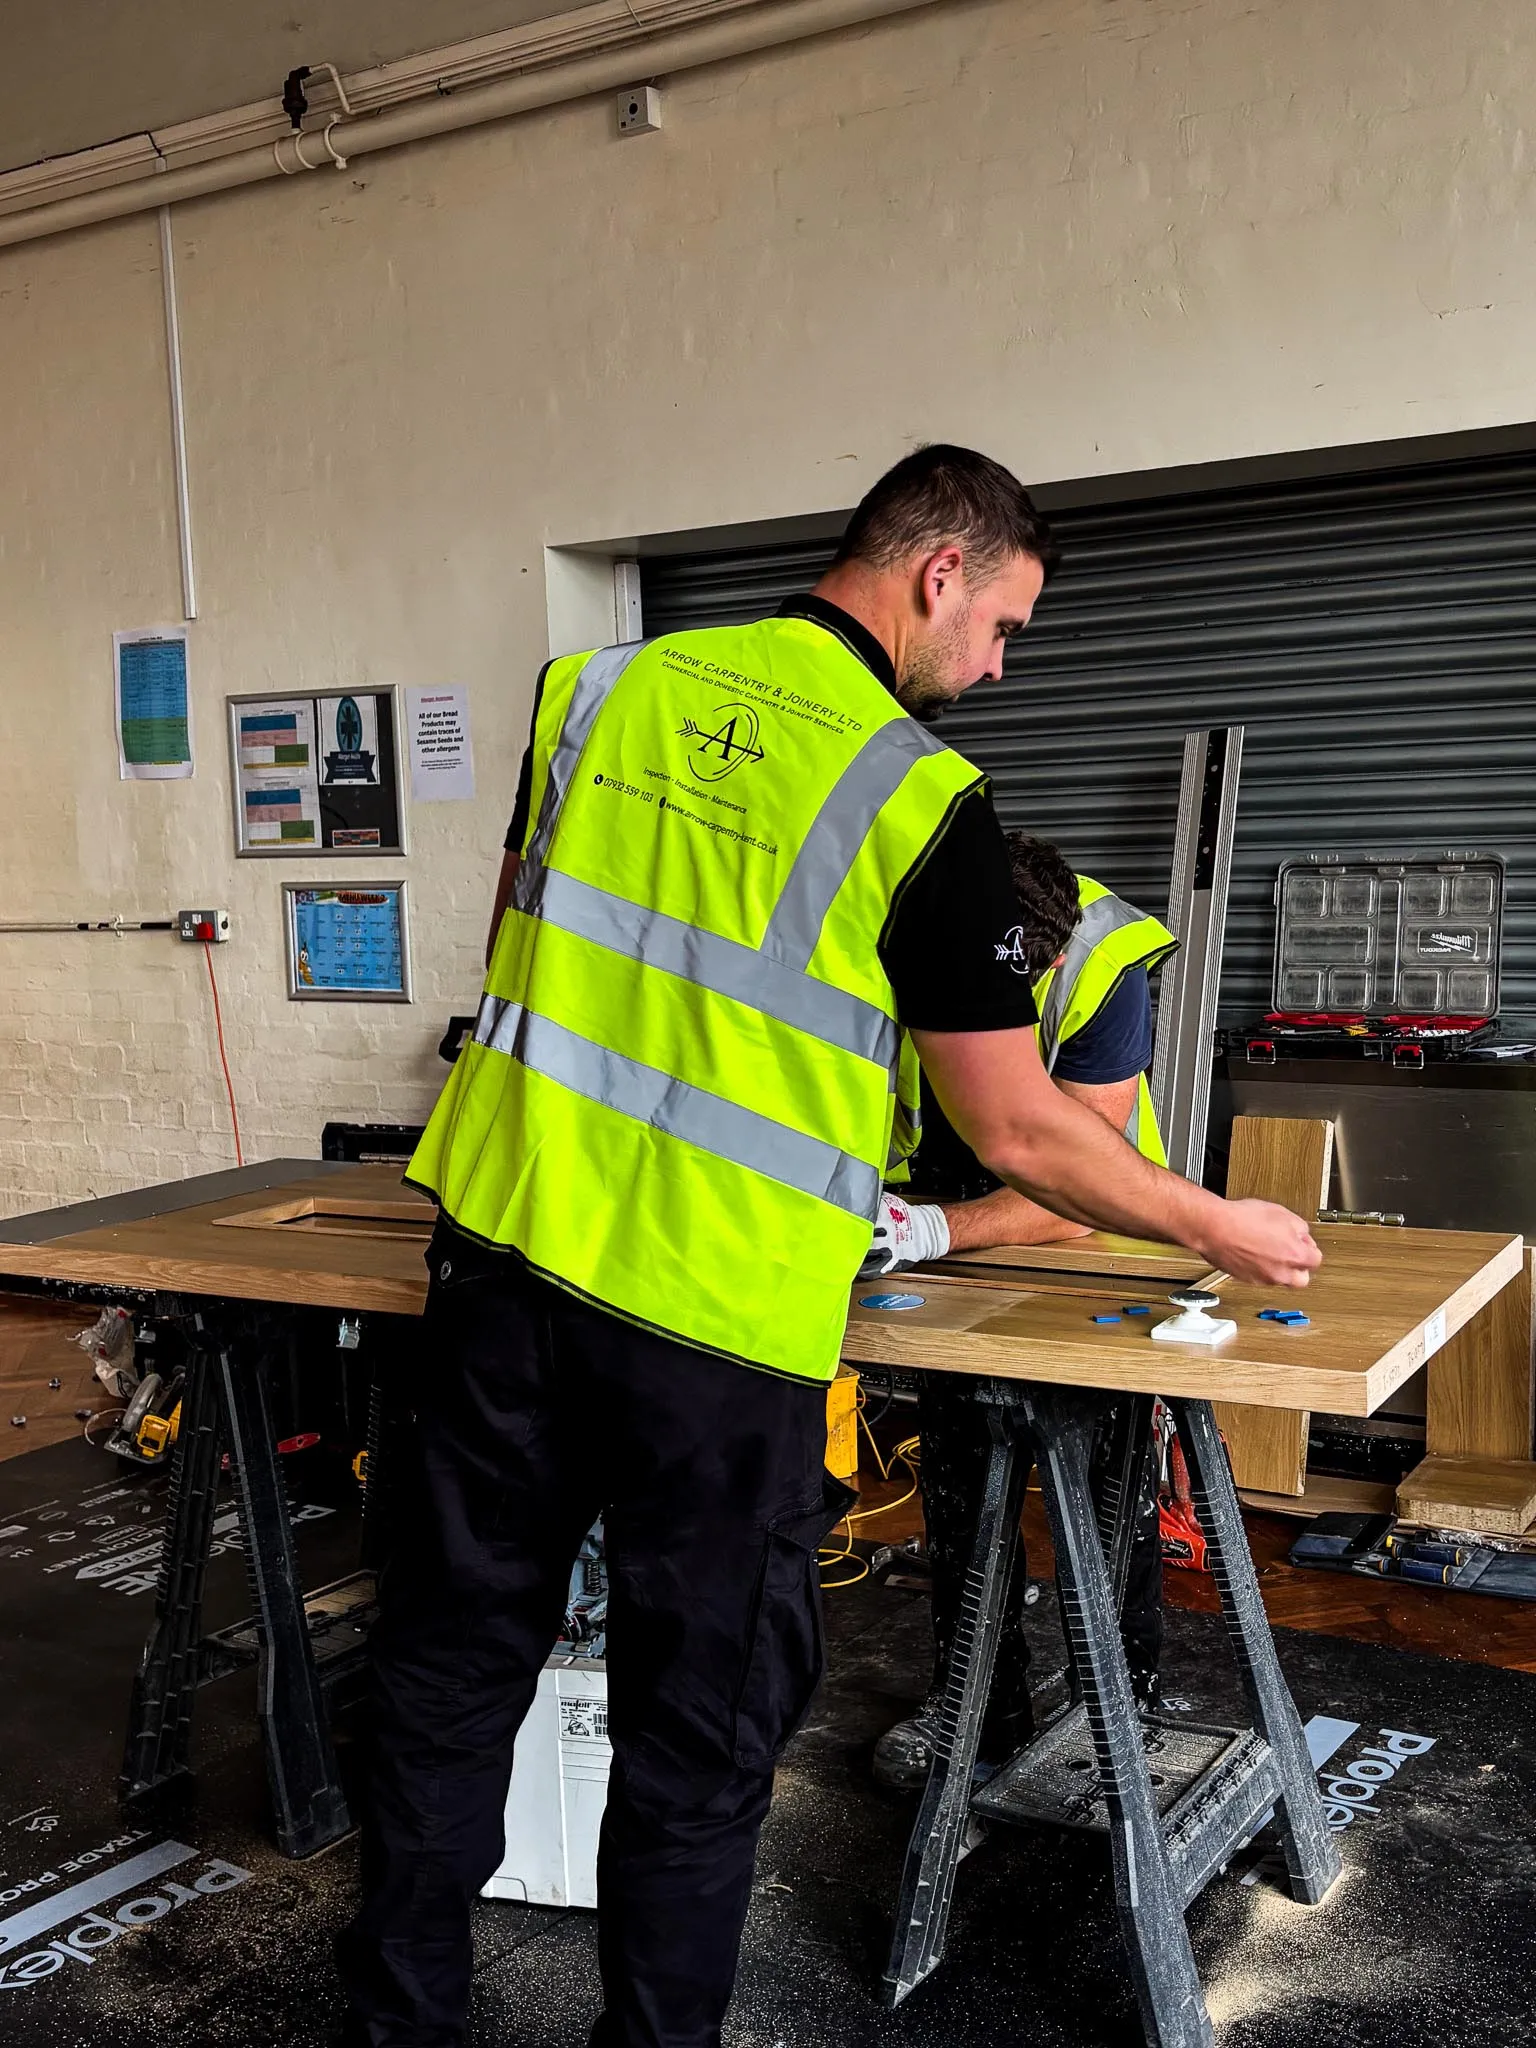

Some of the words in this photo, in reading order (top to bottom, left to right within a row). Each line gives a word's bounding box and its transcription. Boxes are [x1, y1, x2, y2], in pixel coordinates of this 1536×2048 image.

[660, 648, 703, 668] ARROW
[704, 663, 772, 693] CARPENTRY
[772, 687, 782, 698] &
[783, 692, 837, 718] JOINERY
[837, 714, 862, 731] LTD
[436, 745, 460, 753] allergens
[603, 778, 625, 791] 07932
[624, 784, 640, 797] 559
[640, 791, 654, 802] 103
[643, 766, 671, 782] Inspection
[1320, 1728, 1438, 1832] Prople
[58, 1830, 152, 1874] TRADE
